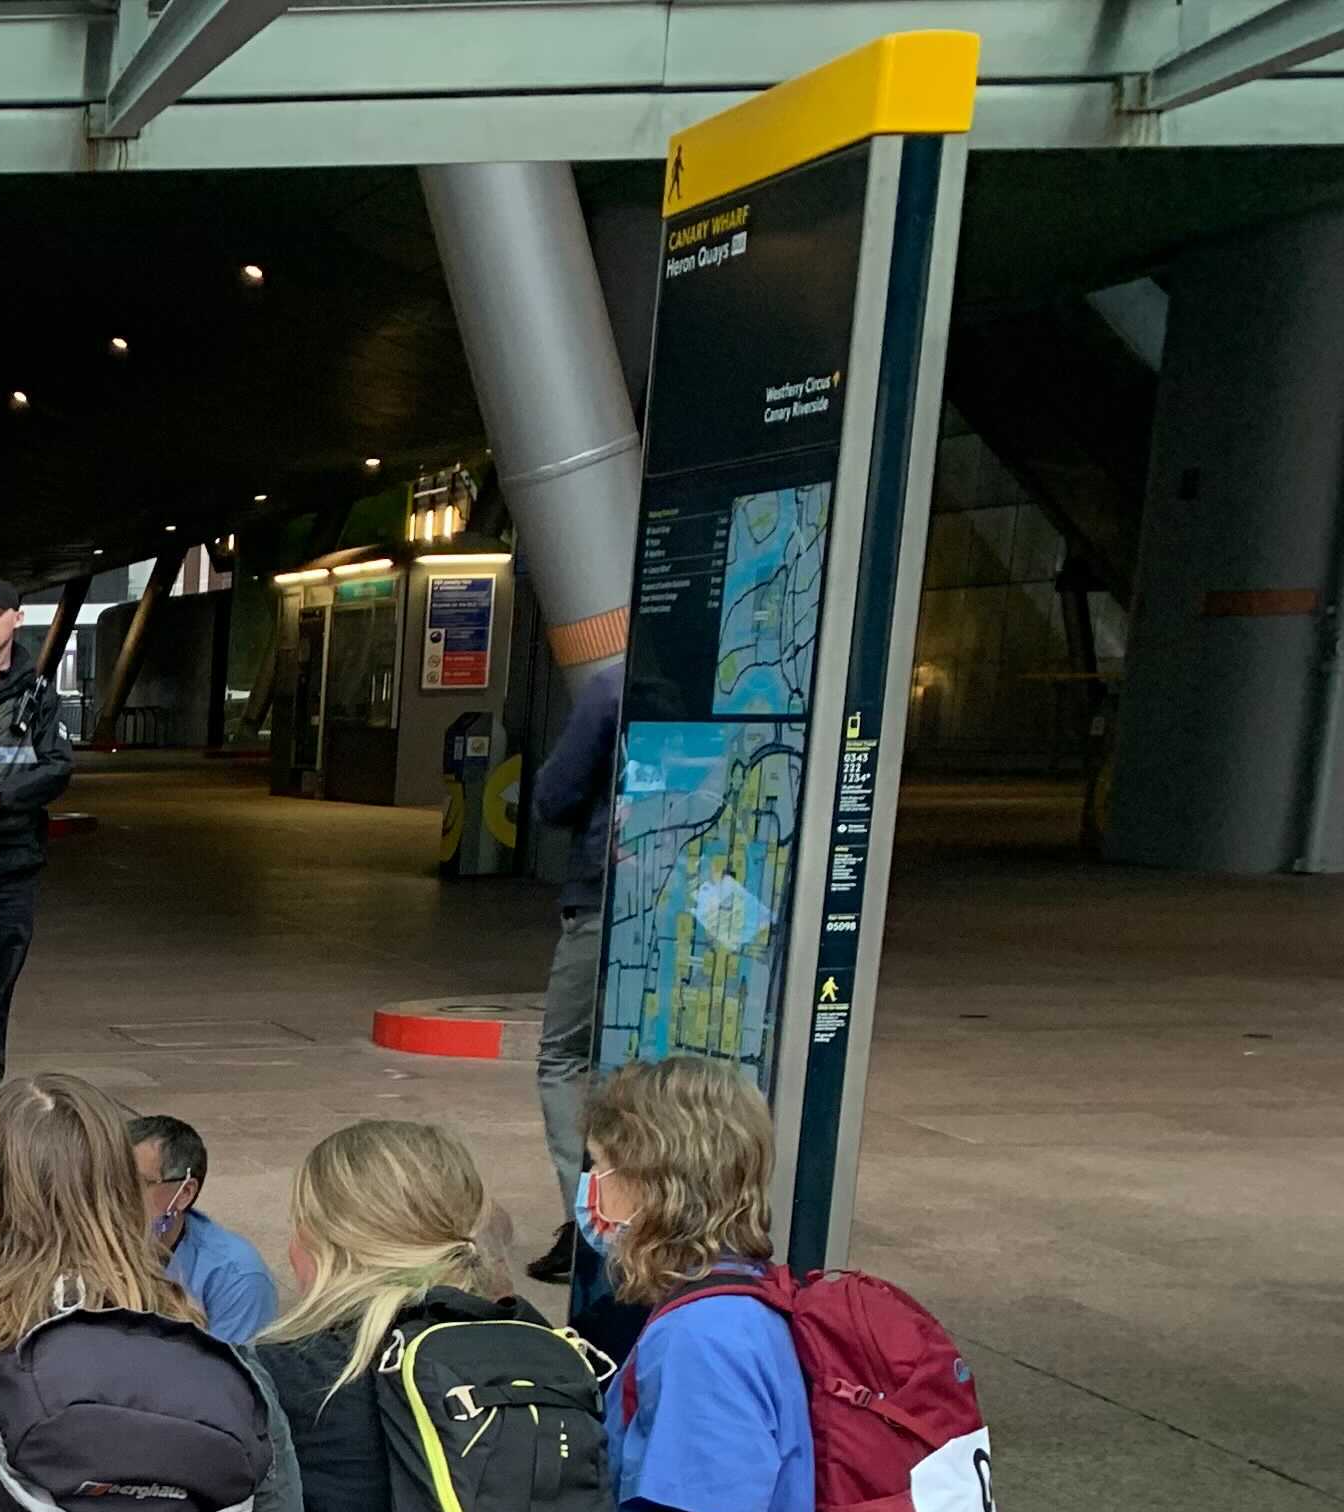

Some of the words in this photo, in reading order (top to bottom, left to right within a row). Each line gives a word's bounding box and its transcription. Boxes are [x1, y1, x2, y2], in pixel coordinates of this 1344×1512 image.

[668, 221, 709, 251] CANARY
[712, 205, 751, 235] WHARF
[666, 254, 696, 278] Heron
[698, 241, 729, 267] Quays
[766, 382, 804, 402] Westferry
[805, 375, 831, 393] Circus
[764, 405, 791, 423] Canary
[793, 396, 830, 417] Riverside
[843, 753, 869, 762] 0343
[843, 763, 861, 773] 222
